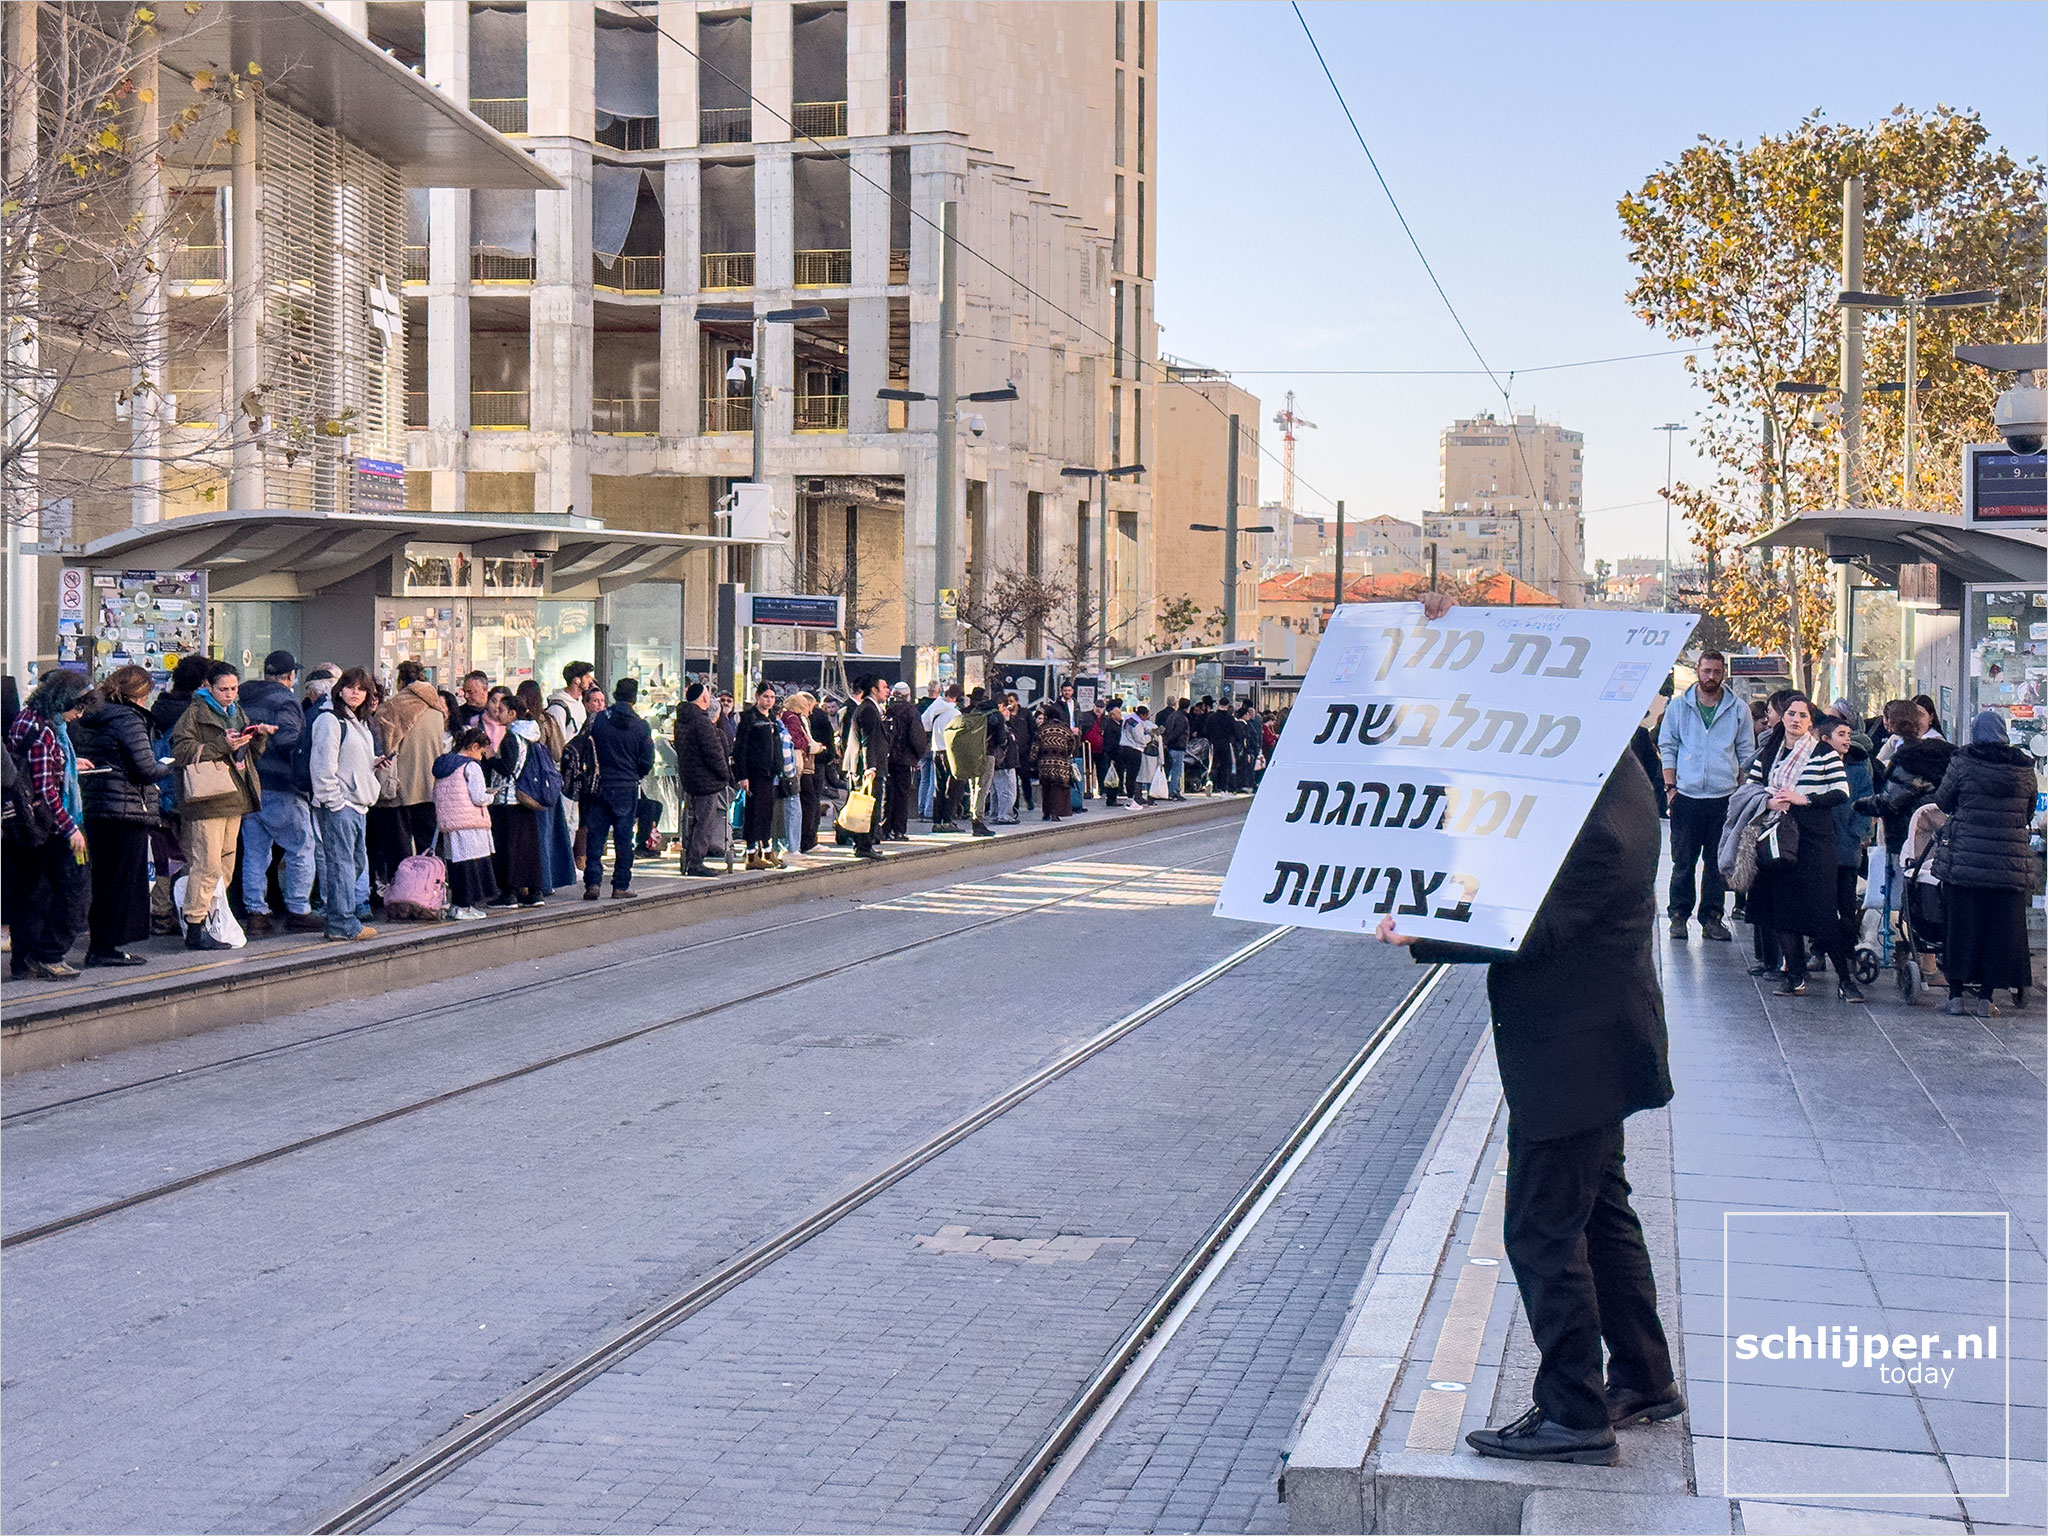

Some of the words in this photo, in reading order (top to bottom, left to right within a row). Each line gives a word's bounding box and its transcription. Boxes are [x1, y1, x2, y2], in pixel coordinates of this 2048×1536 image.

[1375, 614, 1485, 682] מלך
[1491, 634, 1591, 679] בת
[1313, 693, 1582, 759] מתלבשת
[1285, 780, 1538, 840] ומתנהגת
[1263, 861, 1480, 923] בצניעות
